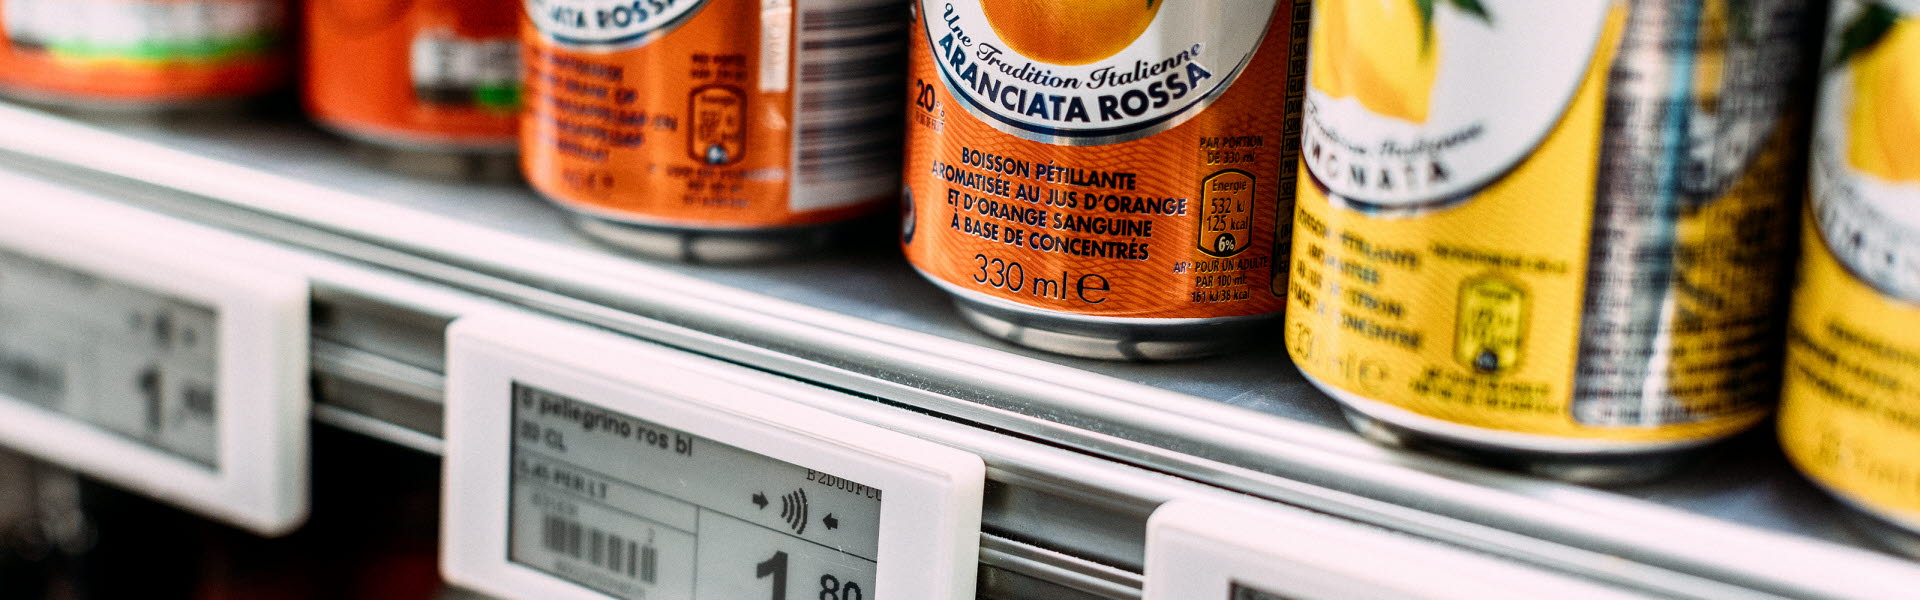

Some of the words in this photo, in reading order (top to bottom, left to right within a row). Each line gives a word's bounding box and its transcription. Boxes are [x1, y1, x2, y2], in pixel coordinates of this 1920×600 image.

[943, 2, 973, 47] Une
[976, 42, 1083, 90] Tradition
[1086, 43, 1202, 89] Italienne
[938, 32, 1091, 123] ARANCIATA
[1098, 61, 1212, 122] ROSSA
[1200, 136, 1220, 151] PAR
[1223, 134, 1263, 149] PORTION
[1207, 151, 1220, 165] DE
[1223, 150, 1240, 164] 330
[1243, 150, 1255, 163] ml
[962, 146, 1030, 179] BOISSON
[1035, 160, 1137, 191] PÉTILLANTE
[932, 160, 1011, 198] AROMATISÉE
[1016, 184, 1041, 203] AU
[1045, 188, 1078, 209] JUS
[1084, 193, 1188, 216] D'ORANGE
[1212, 179, 1247, 195] Energie
[948, 187, 961, 208] ET
[963, 193, 1048, 228] D'ORANGE
[1053, 212, 1153, 238] SANGUINE
[1211, 197, 1232, 215] 532
[951, 208, 961, 231] À
[964, 216, 999, 242] BASE
[1004, 226, 1024, 247] DE
[1029, 231, 1150, 261] CONCENTRÉS
[1207, 214, 1227, 232] 125
[1230, 215, 1249, 231] kcal
[1218, 236, 1235, 252] 6%
[974, 253, 1025, 293] 330
[1033, 270, 1068, 300] ml
[1076, 273, 1110, 304] e
[1195, 259, 1220, 274] POUR
[1222, 258, 1235, 273] UN
[1237, 255, 1268, 270] ADULTE
[1191, 291, 1207, 304] 161
[1233, 287, 1250, 301] kcal
[1196, 275, 1214, 288] PAR
[1217, 274, 1232, 287] 100
[540, 398, 632, 439] pellegrino
[637, 424, 669, 450] ros
[675, 433, 694, 458] bl
[755, 549, 789, 600] 1
[819, 573, 863, 600] 80
